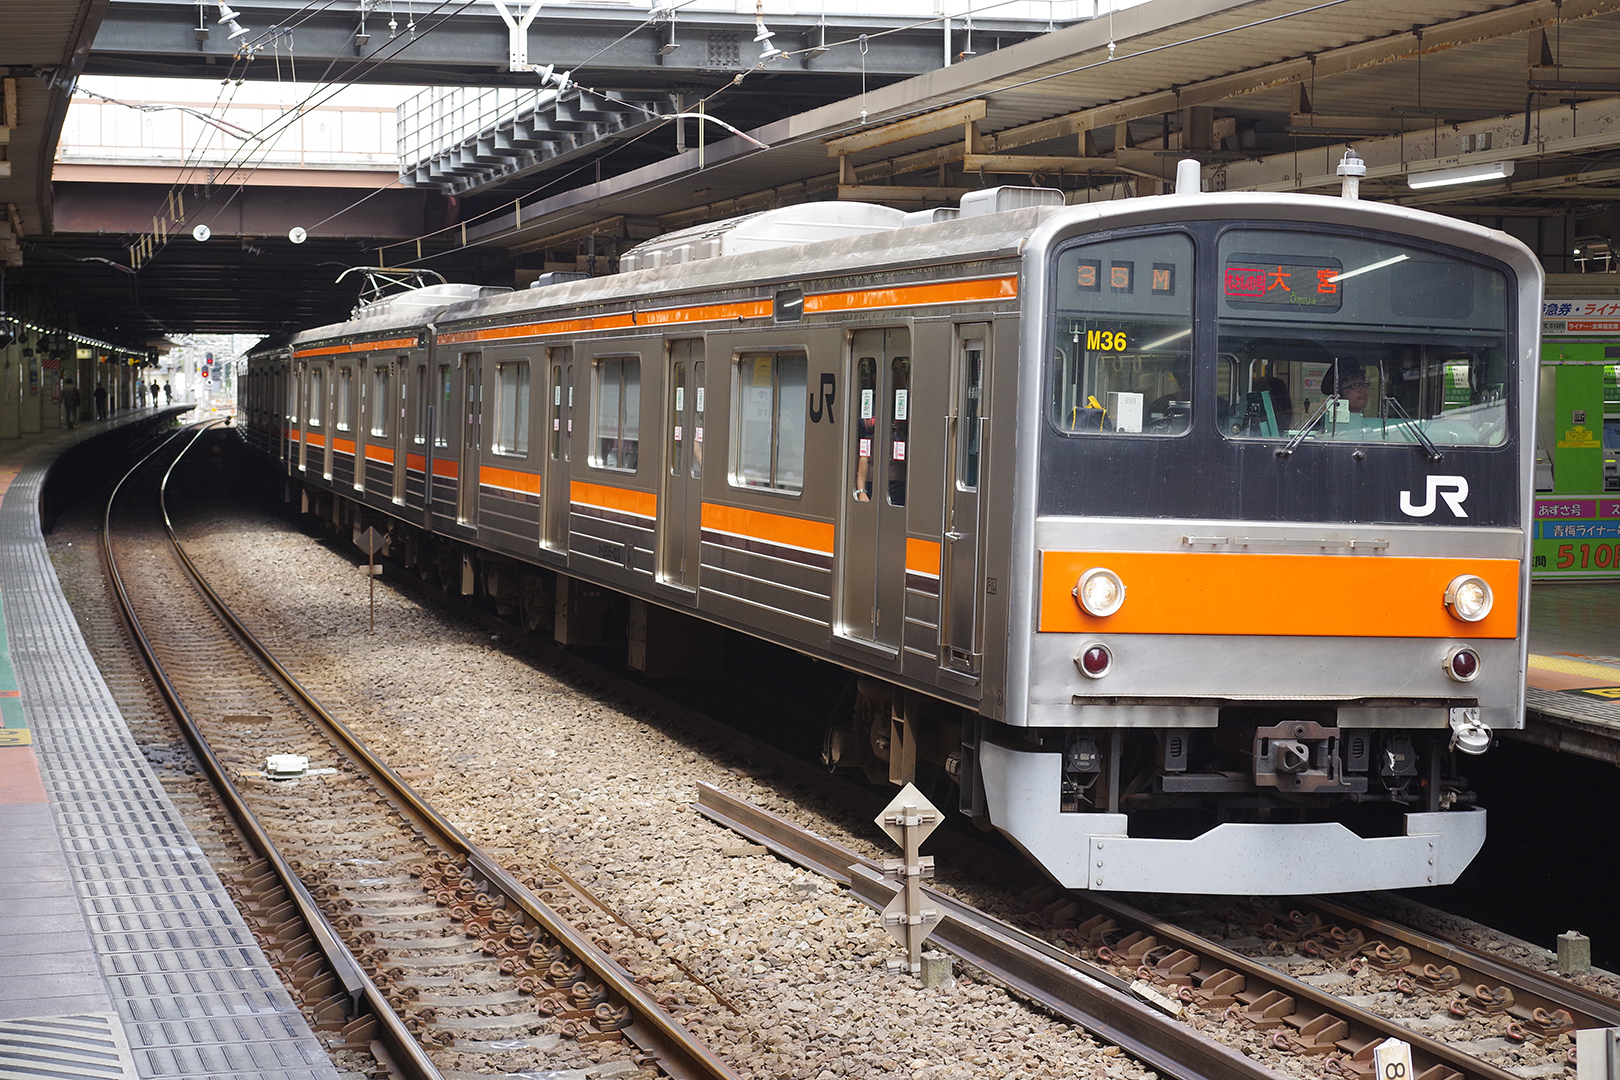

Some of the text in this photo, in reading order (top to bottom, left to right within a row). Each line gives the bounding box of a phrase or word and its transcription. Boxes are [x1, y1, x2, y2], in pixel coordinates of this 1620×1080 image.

[1226, 274, 1263, 291] むさしの号
[1086, 329, 1127, 352] M36
[809, 372, 836, 424] JR
[1400, 475, 1469, 518] JR
[1538, 503, 1582, 517] あずさ号
[1532, 555, 1547, 568] 間
